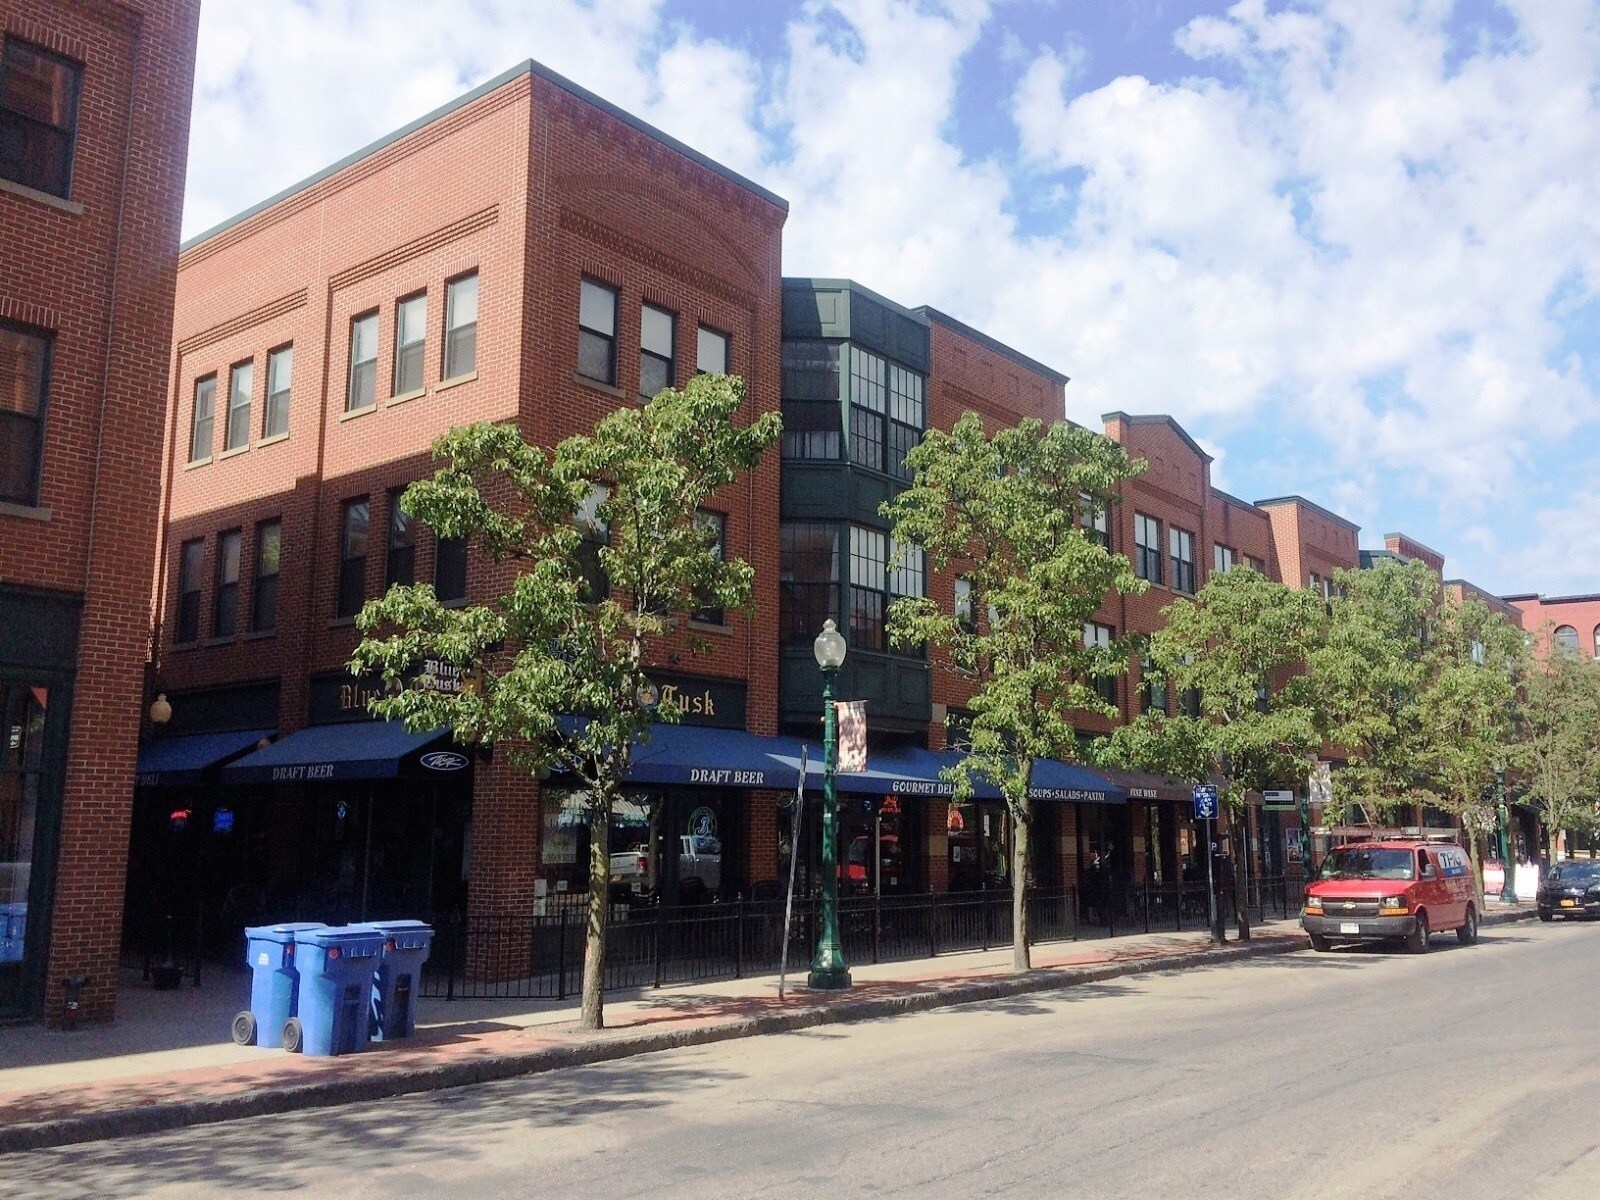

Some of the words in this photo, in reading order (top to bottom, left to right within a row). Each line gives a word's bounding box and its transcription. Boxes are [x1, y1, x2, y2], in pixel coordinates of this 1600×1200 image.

[661, 684, 715, 716] Tusk
[273, 766, 305, 780] DRAFT
[307, 764, 334, 779] BEER
[690, 768, 732, 783] DRAFT
[733, 770, 765, 784] BEER
[892, 780, 936, 794] GOURMET
